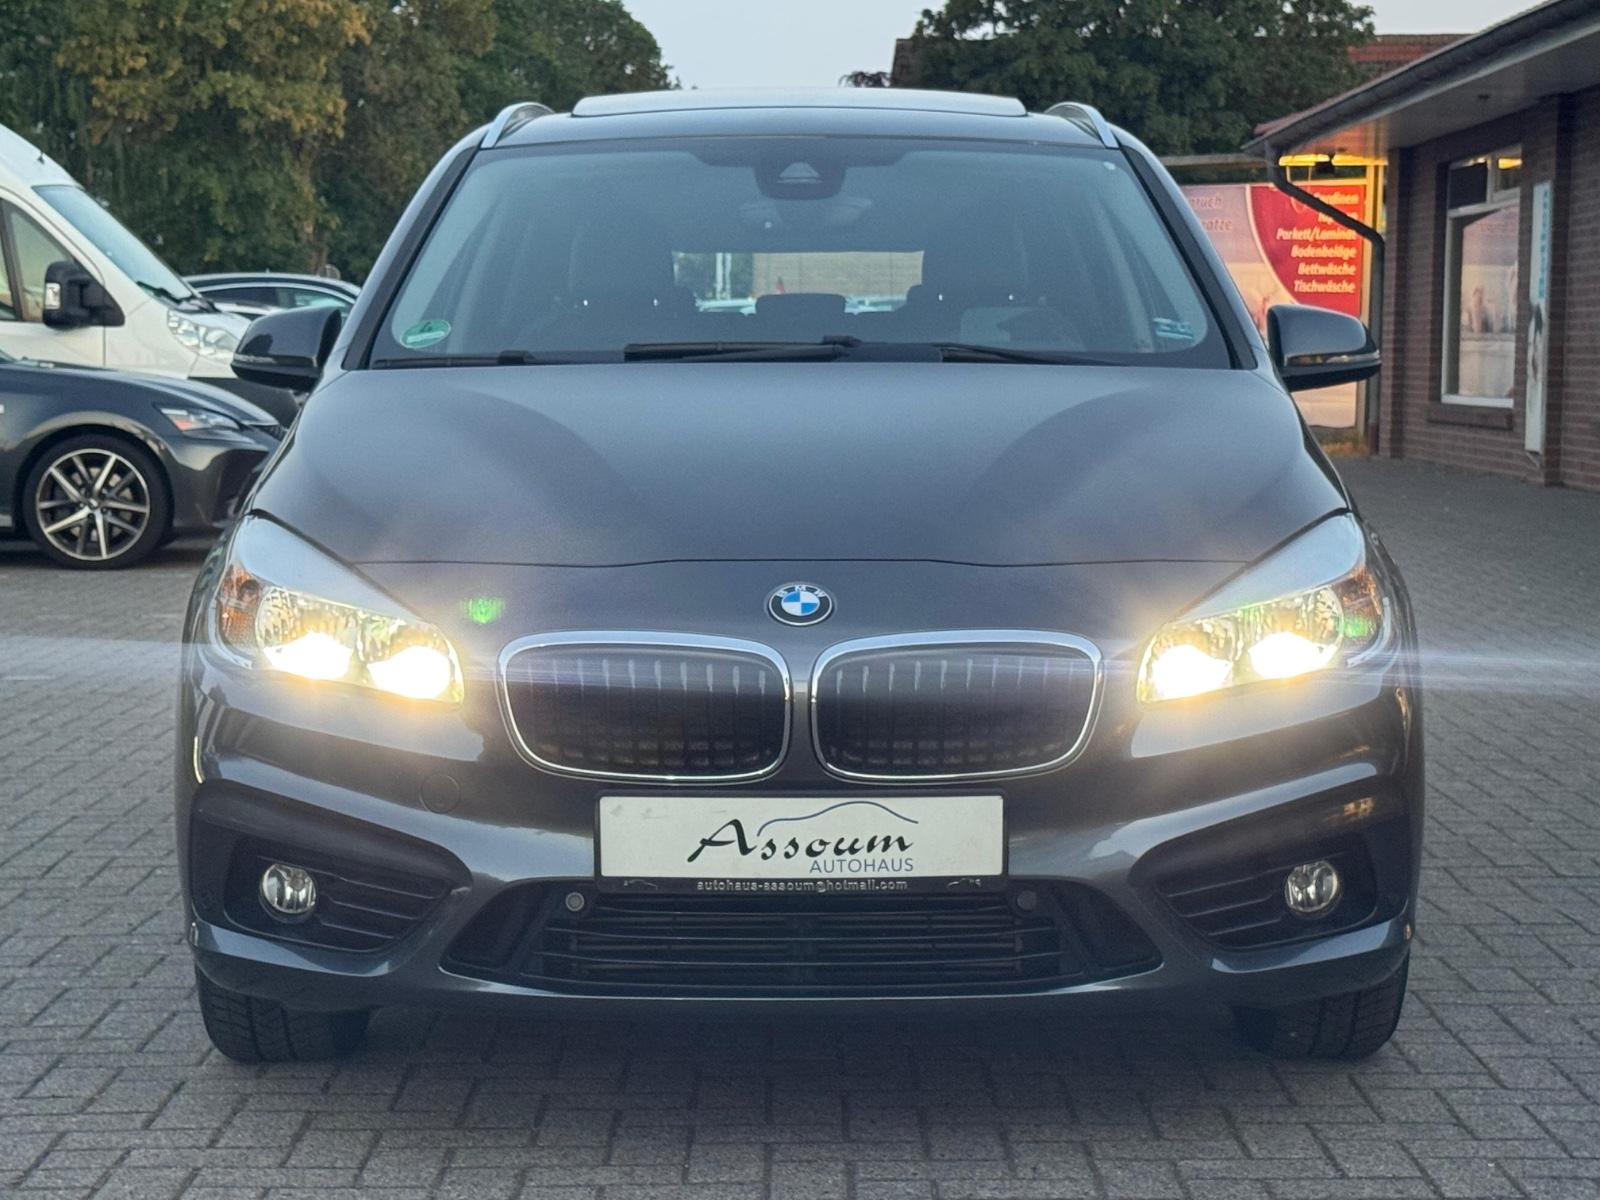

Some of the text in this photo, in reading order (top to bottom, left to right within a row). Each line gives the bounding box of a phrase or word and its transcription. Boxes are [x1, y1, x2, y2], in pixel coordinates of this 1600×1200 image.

[1294, 279, 1356, 294] Tischwäsche
[687, 819, 914, 863] Assoum
[809, 858, 914, 875] AUTOHAUS
[695, 879, 909, 893] autohaus-assoum@hotmail.com
